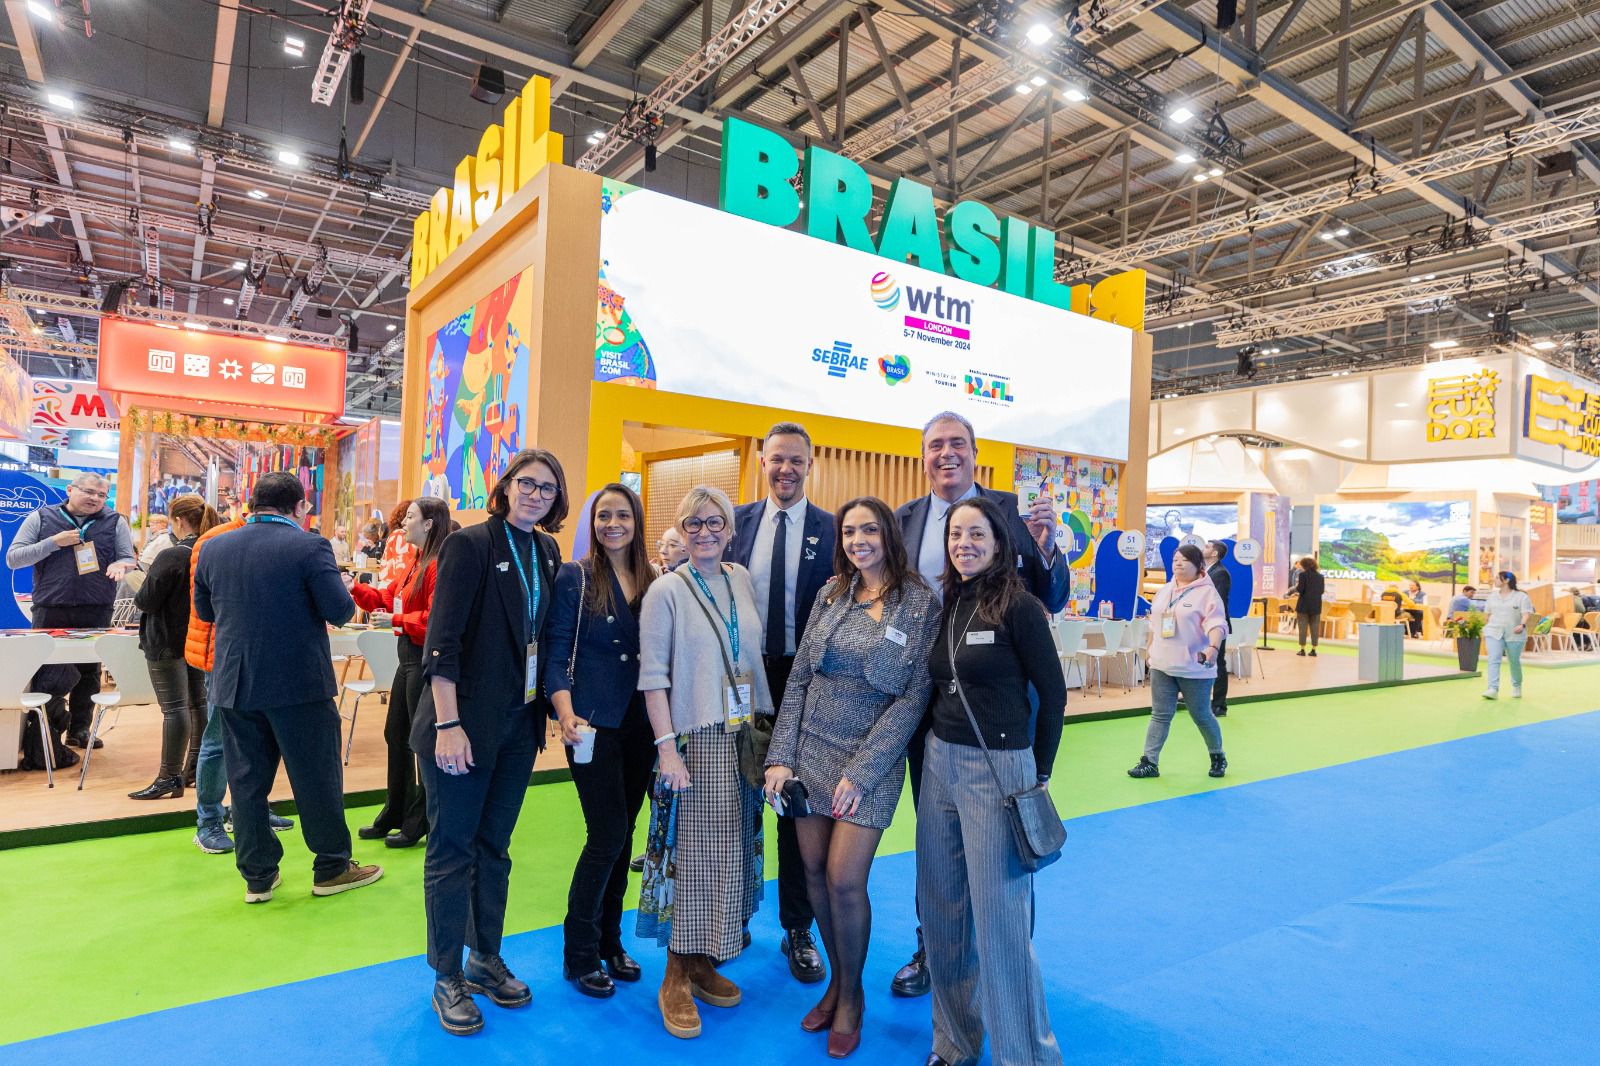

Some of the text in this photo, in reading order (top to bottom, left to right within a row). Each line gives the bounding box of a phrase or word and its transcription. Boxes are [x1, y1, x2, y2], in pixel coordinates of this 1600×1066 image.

[410, 74, 564, 291] BRASIL
[720, 116, 1071, 312] BRASIL
[906, 286, 971, 325] wtm
[923, 321, 952, 336] LONDON
[904, 328, 971, 350] 5-7 November 2024
[600, 350, 622, 360] VISIT
[811, 348, 869, 371] SEBRAE
[600, 358, 630, 370] BRASIL
[600, 365, 622, 376] .COM
[886, 365, 906, 376] BRASIL
[935, 379, 957, 388] TOURISM
[1425, 417, 1496, 442] DOR
[0, 500, 34, 509] BRASIL
[1242, 543, 1252, 551] 53
[1320, 569, 1376, 580] ECUADOR
